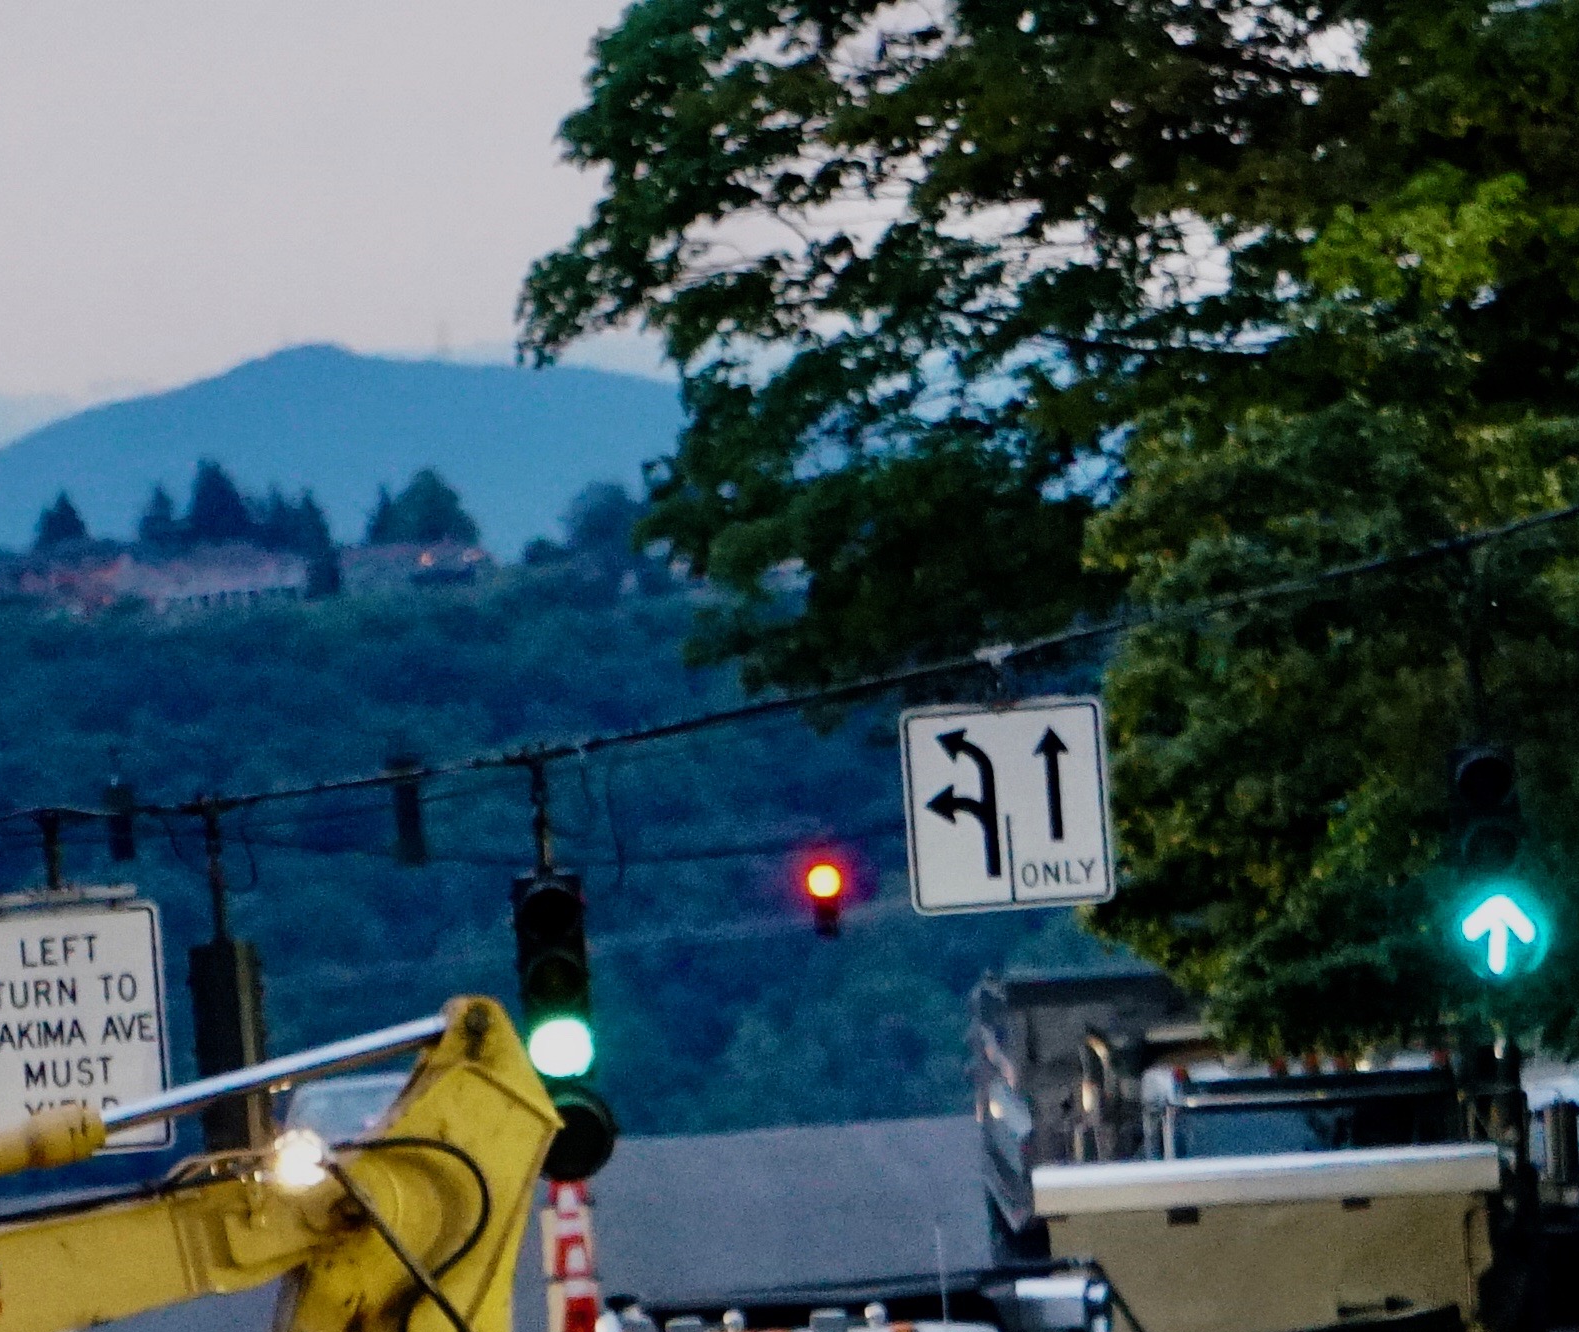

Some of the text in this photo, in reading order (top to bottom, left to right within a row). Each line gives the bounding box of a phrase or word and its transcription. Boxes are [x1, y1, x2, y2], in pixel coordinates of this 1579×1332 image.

[1021, 857, 1096, 889] ONLY
[19, 933, 98, 969] LEFT
[98, 973, 138, 1005] TO
[100, 1011, 157, 1045] AVE
[24, 1055, 113, 1092] MUST
